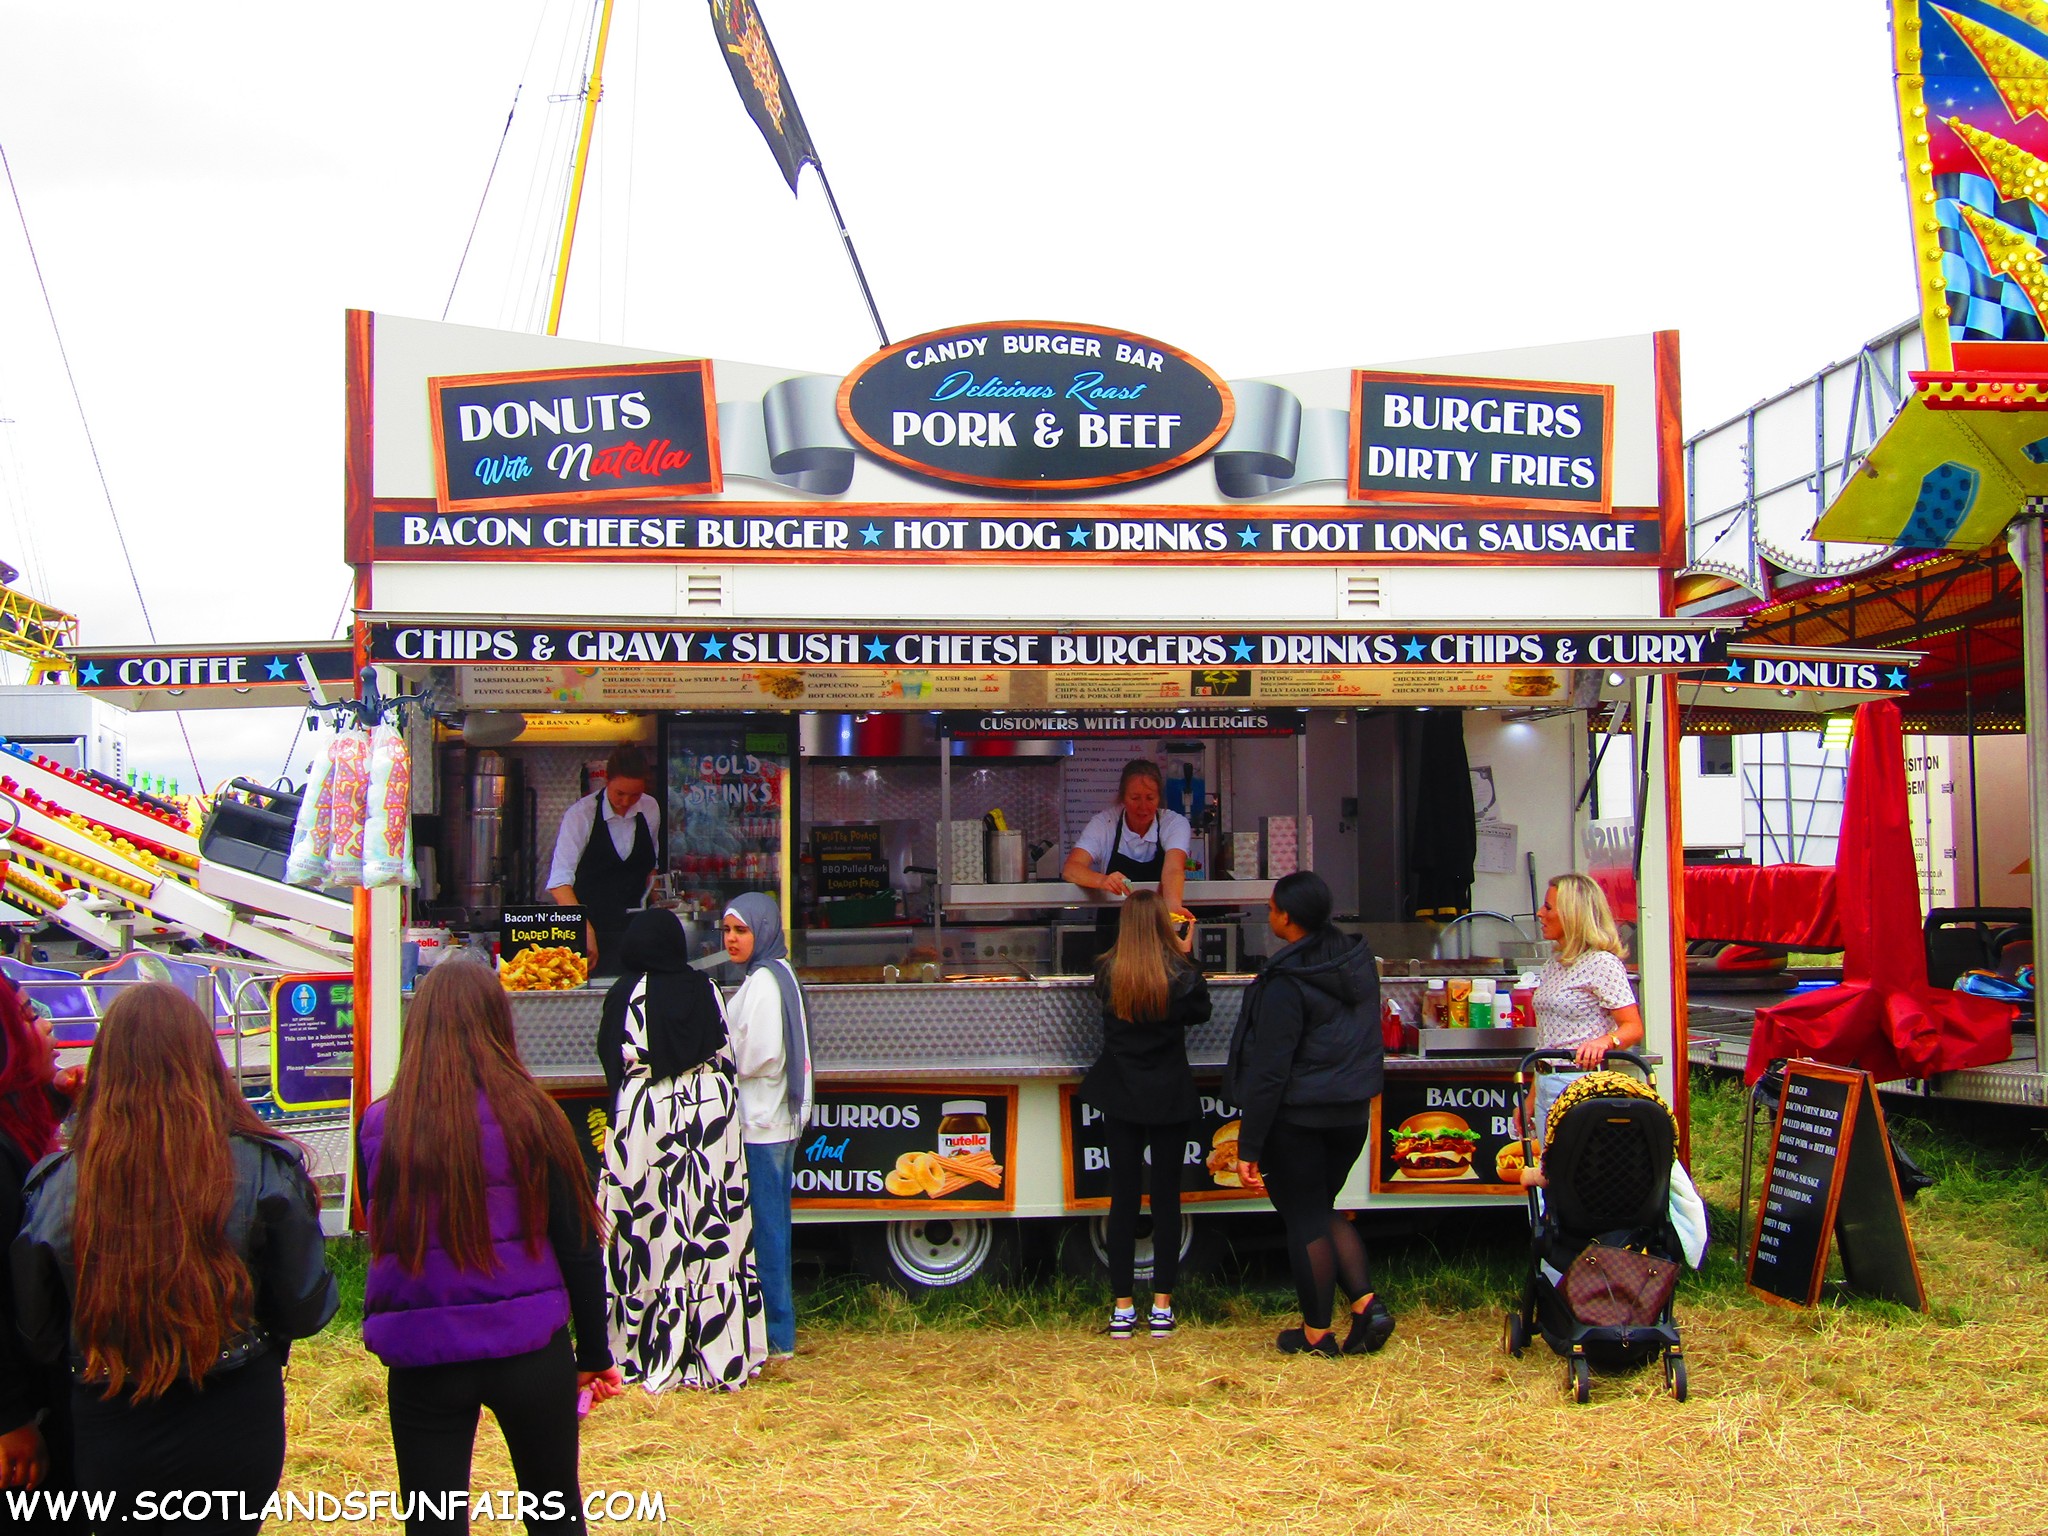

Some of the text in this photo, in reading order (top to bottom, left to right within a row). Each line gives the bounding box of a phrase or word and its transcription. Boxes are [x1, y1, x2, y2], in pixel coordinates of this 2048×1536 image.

[905, 335, 1164, 372] CANDY BURGER BAR
[929, 370, 1148, 411] Delicious Roast
[459, 391, 651, 442] DONUTS
[1383, 393, 1582, 439] BURGERS
[892, 411, 1182, 449] PORK & BEEF
[475, 439, 692, 486] With Nutella
[1368, 445, 1595, 489] DIRTY FRIES
[403, 516, 850, 550] BACON CHEESE BURGER
[893, 521, 1061, 550] HOT DOG
[1095, 522, 1228, 552] DRINKS
[1272, 522, 1635, 552] FOOT LONG SAUSAGE
[395, 629, 695, 662] CHIPS & GRAVY
[732, 632, 859, 664] SLUSH
[894, 634, 1227, 665] CHEESE BURGERS
[1261, 634, 1398, 665] DRINKS
[1430, 634, 1707, 664] CHIPS & CURRY
[118, 657, 247, 686] COFFEE
[1753, 659, 1878, 690] DONUTS
[980, 715, 1269, 730] CUSTOMERS WITH FOOD ALLERGIES
[700, 754, 761, 776] COLD
[689, 782, 773, 805] DRINKS
[815, 830, 878, 843] TWISTER POTATO
[822, 864, 888, 874] BBQ Pulled Pork
[828, 878, 858, 890] LOADED
[504, 913, 534, 923] Bacon
[549, 911, 582, 922] cheese
[511, 927, 577, 942] LOADED FRIES
[1426, 1087, 1505, 1108] BACON
[1788, 1084, 1808, 1097] BURGER
[1785, 1101, 1839, 1121] BACON CHEESE BURGER
[1782, 1117, 1833, 1137] PULLED PORK BURGER
[805, 1134, 850, 1163] And
[945, 1134, 987, 1146] nutella
[1779, 1133, 1795, 1146] ROAST
[1795, 1137, 1808, 1150] PORK
[1813, 1142, 1825, 1154] BEEF
[1824, 1145, 1836, 1157] ROLL
[1775, 1150, 1798, 1164] HOT DOG
[1773, 1166, 1820, 1188] FOOT LONG SAUSAGE
[1769, 1183, 1813, 1204] FULLY LOADED DOG
[1766, 1200, 1782, 1213] CHIPS
[1763, 1216, 1791, 1233] DIRTY FRIES
[1760, 1233, 1780, 1247] DONUTS
[1757, 1250, 1777, 1265] WAFFLES
